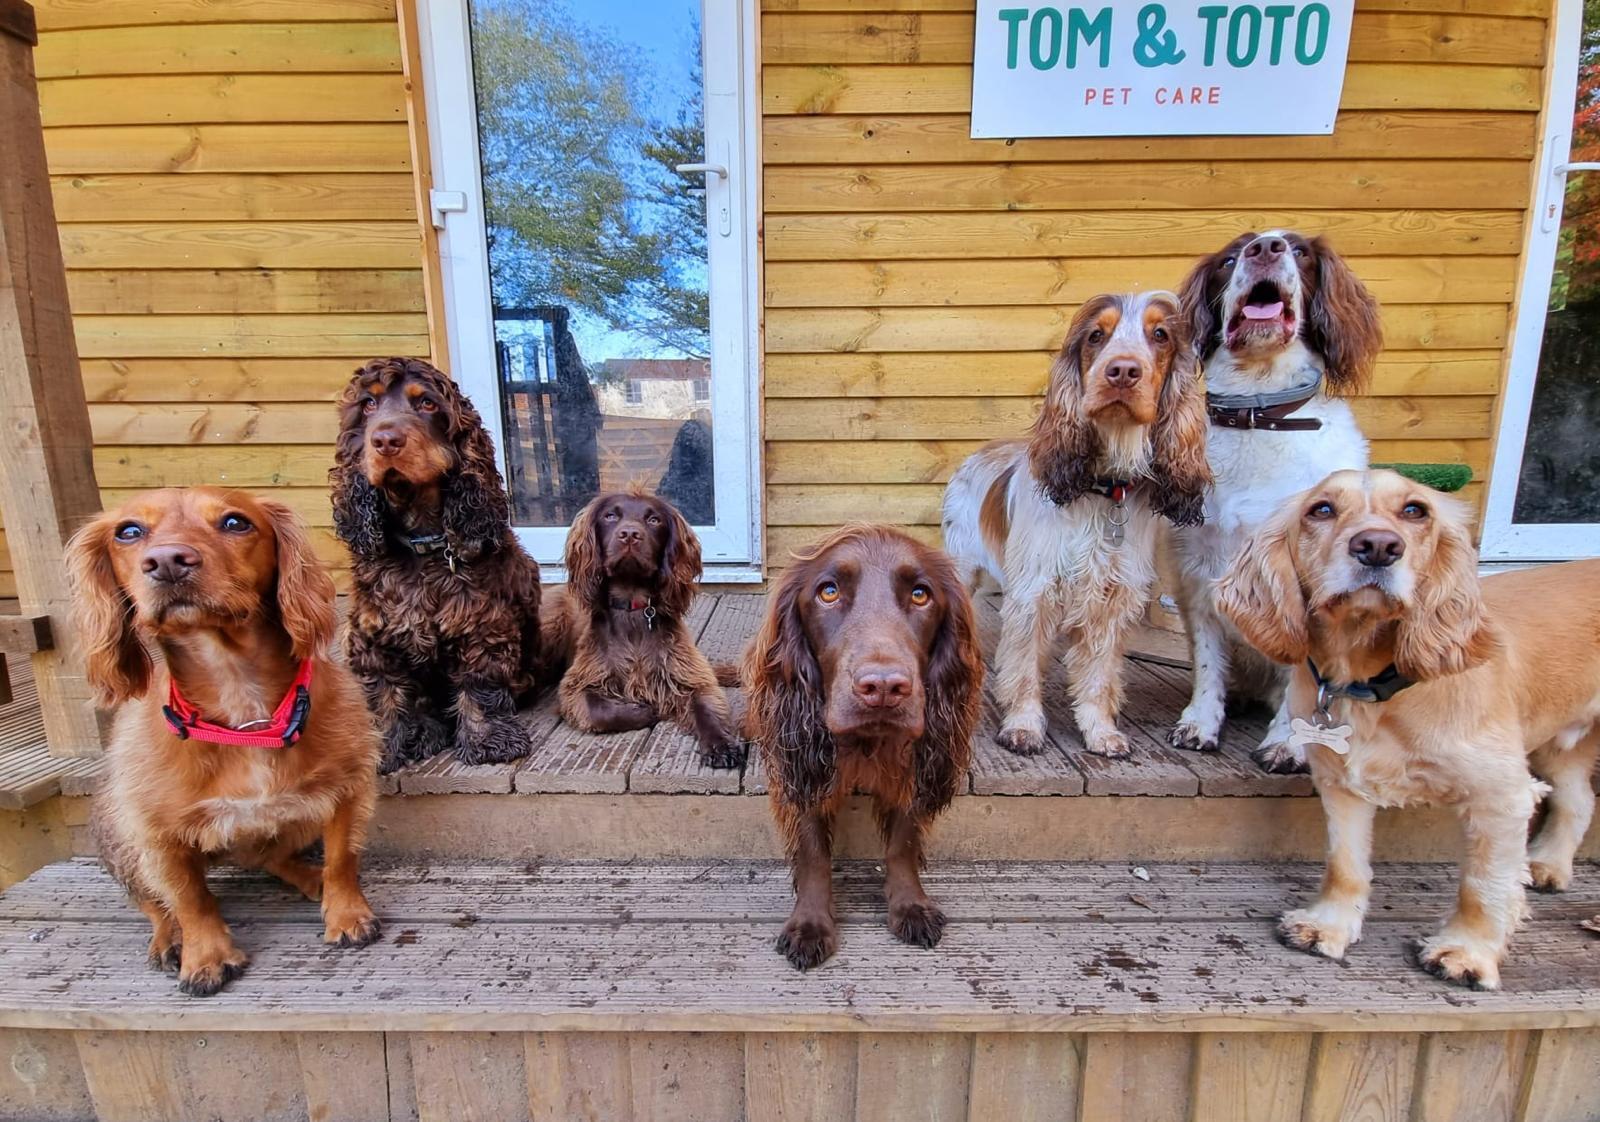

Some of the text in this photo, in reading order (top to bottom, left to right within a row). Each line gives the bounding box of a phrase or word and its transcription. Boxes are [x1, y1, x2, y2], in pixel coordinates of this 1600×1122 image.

[998, 2, 1331, 71] TOM & TOTO
[1085, 86, 1222, 106] PET CARE
